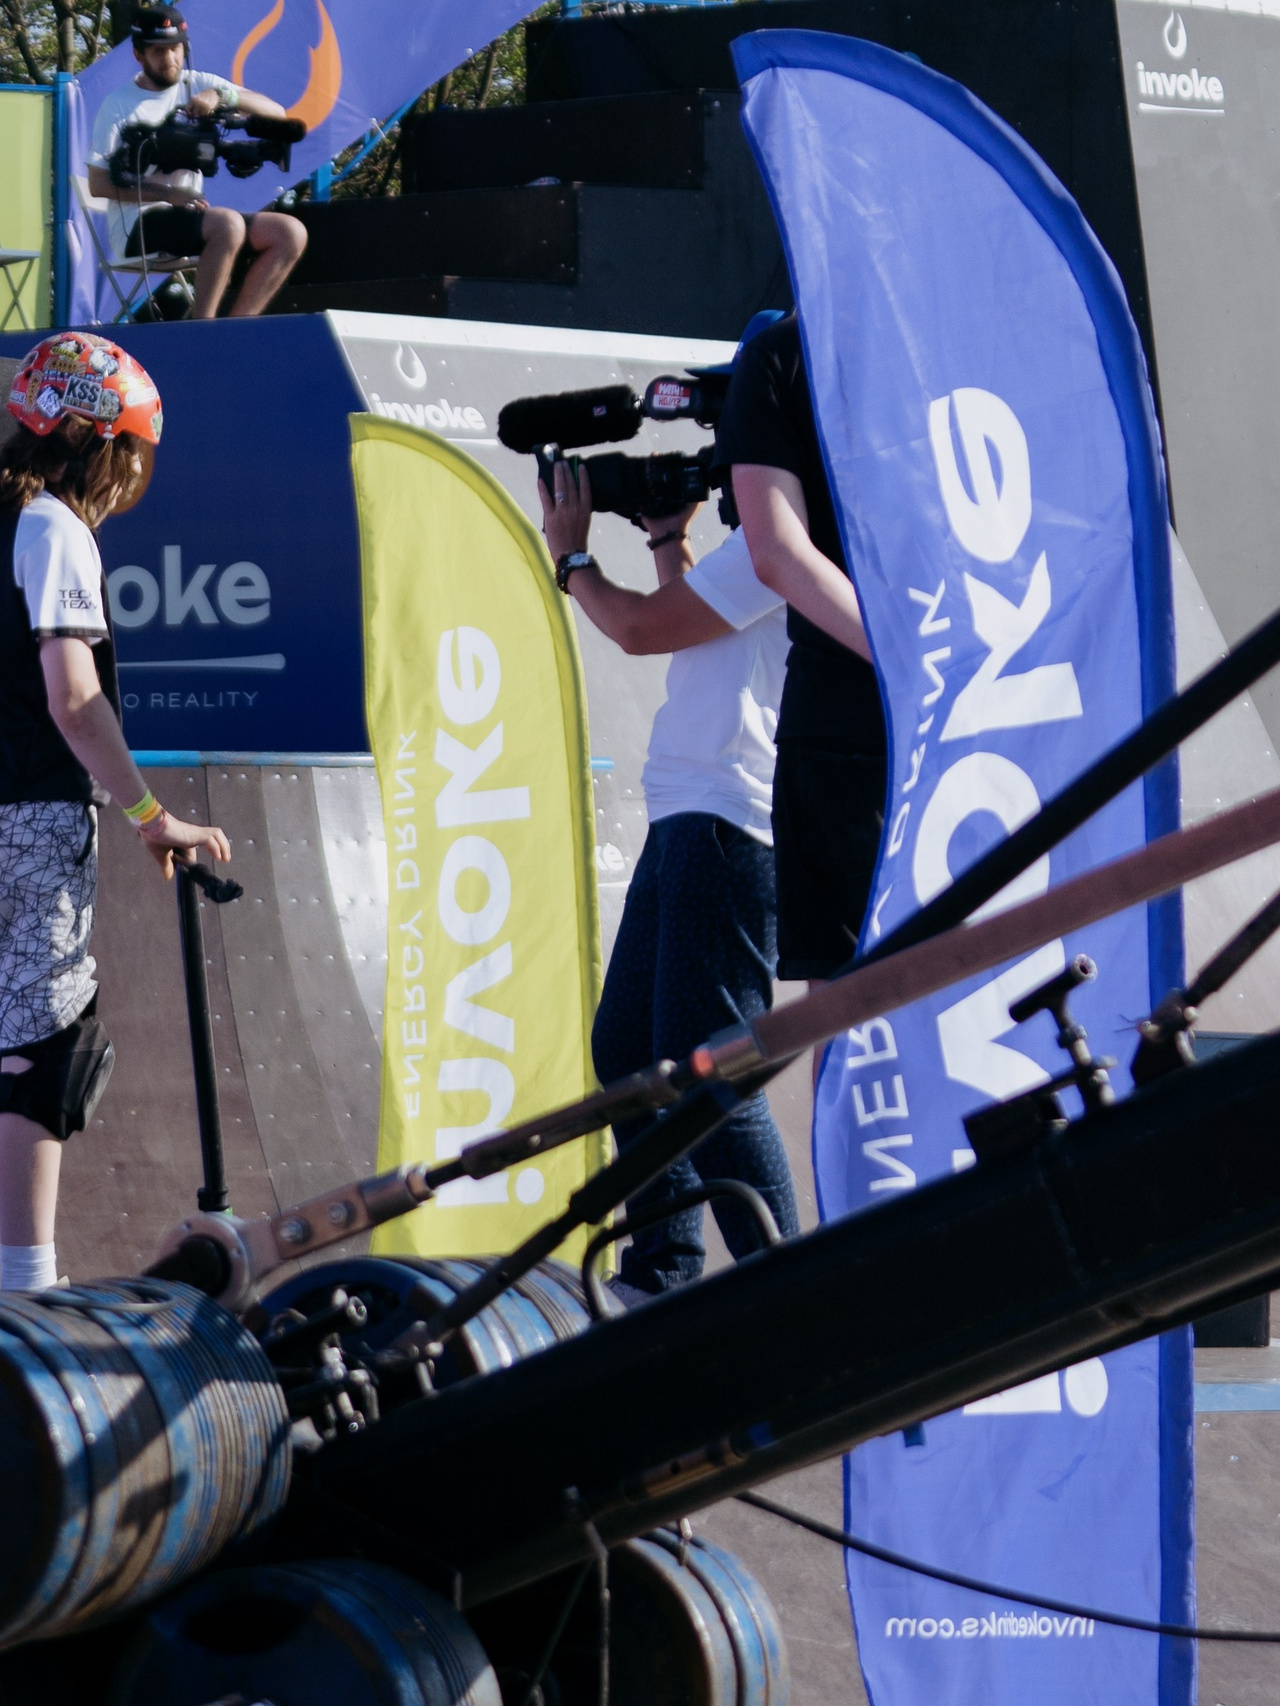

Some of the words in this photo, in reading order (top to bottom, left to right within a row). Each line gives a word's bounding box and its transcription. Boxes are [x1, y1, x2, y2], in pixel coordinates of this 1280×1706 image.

[1136, 61, 1224, 101] invoke
[66, 379, 101, 403] KSS
[371, 392, 487, 430] invoke
[58, 588, 92, 600] TEC
[107, 544, 271, 628] oke
[123, 693, 140, 709] O
[150, 690, 259, 709] REALITY
